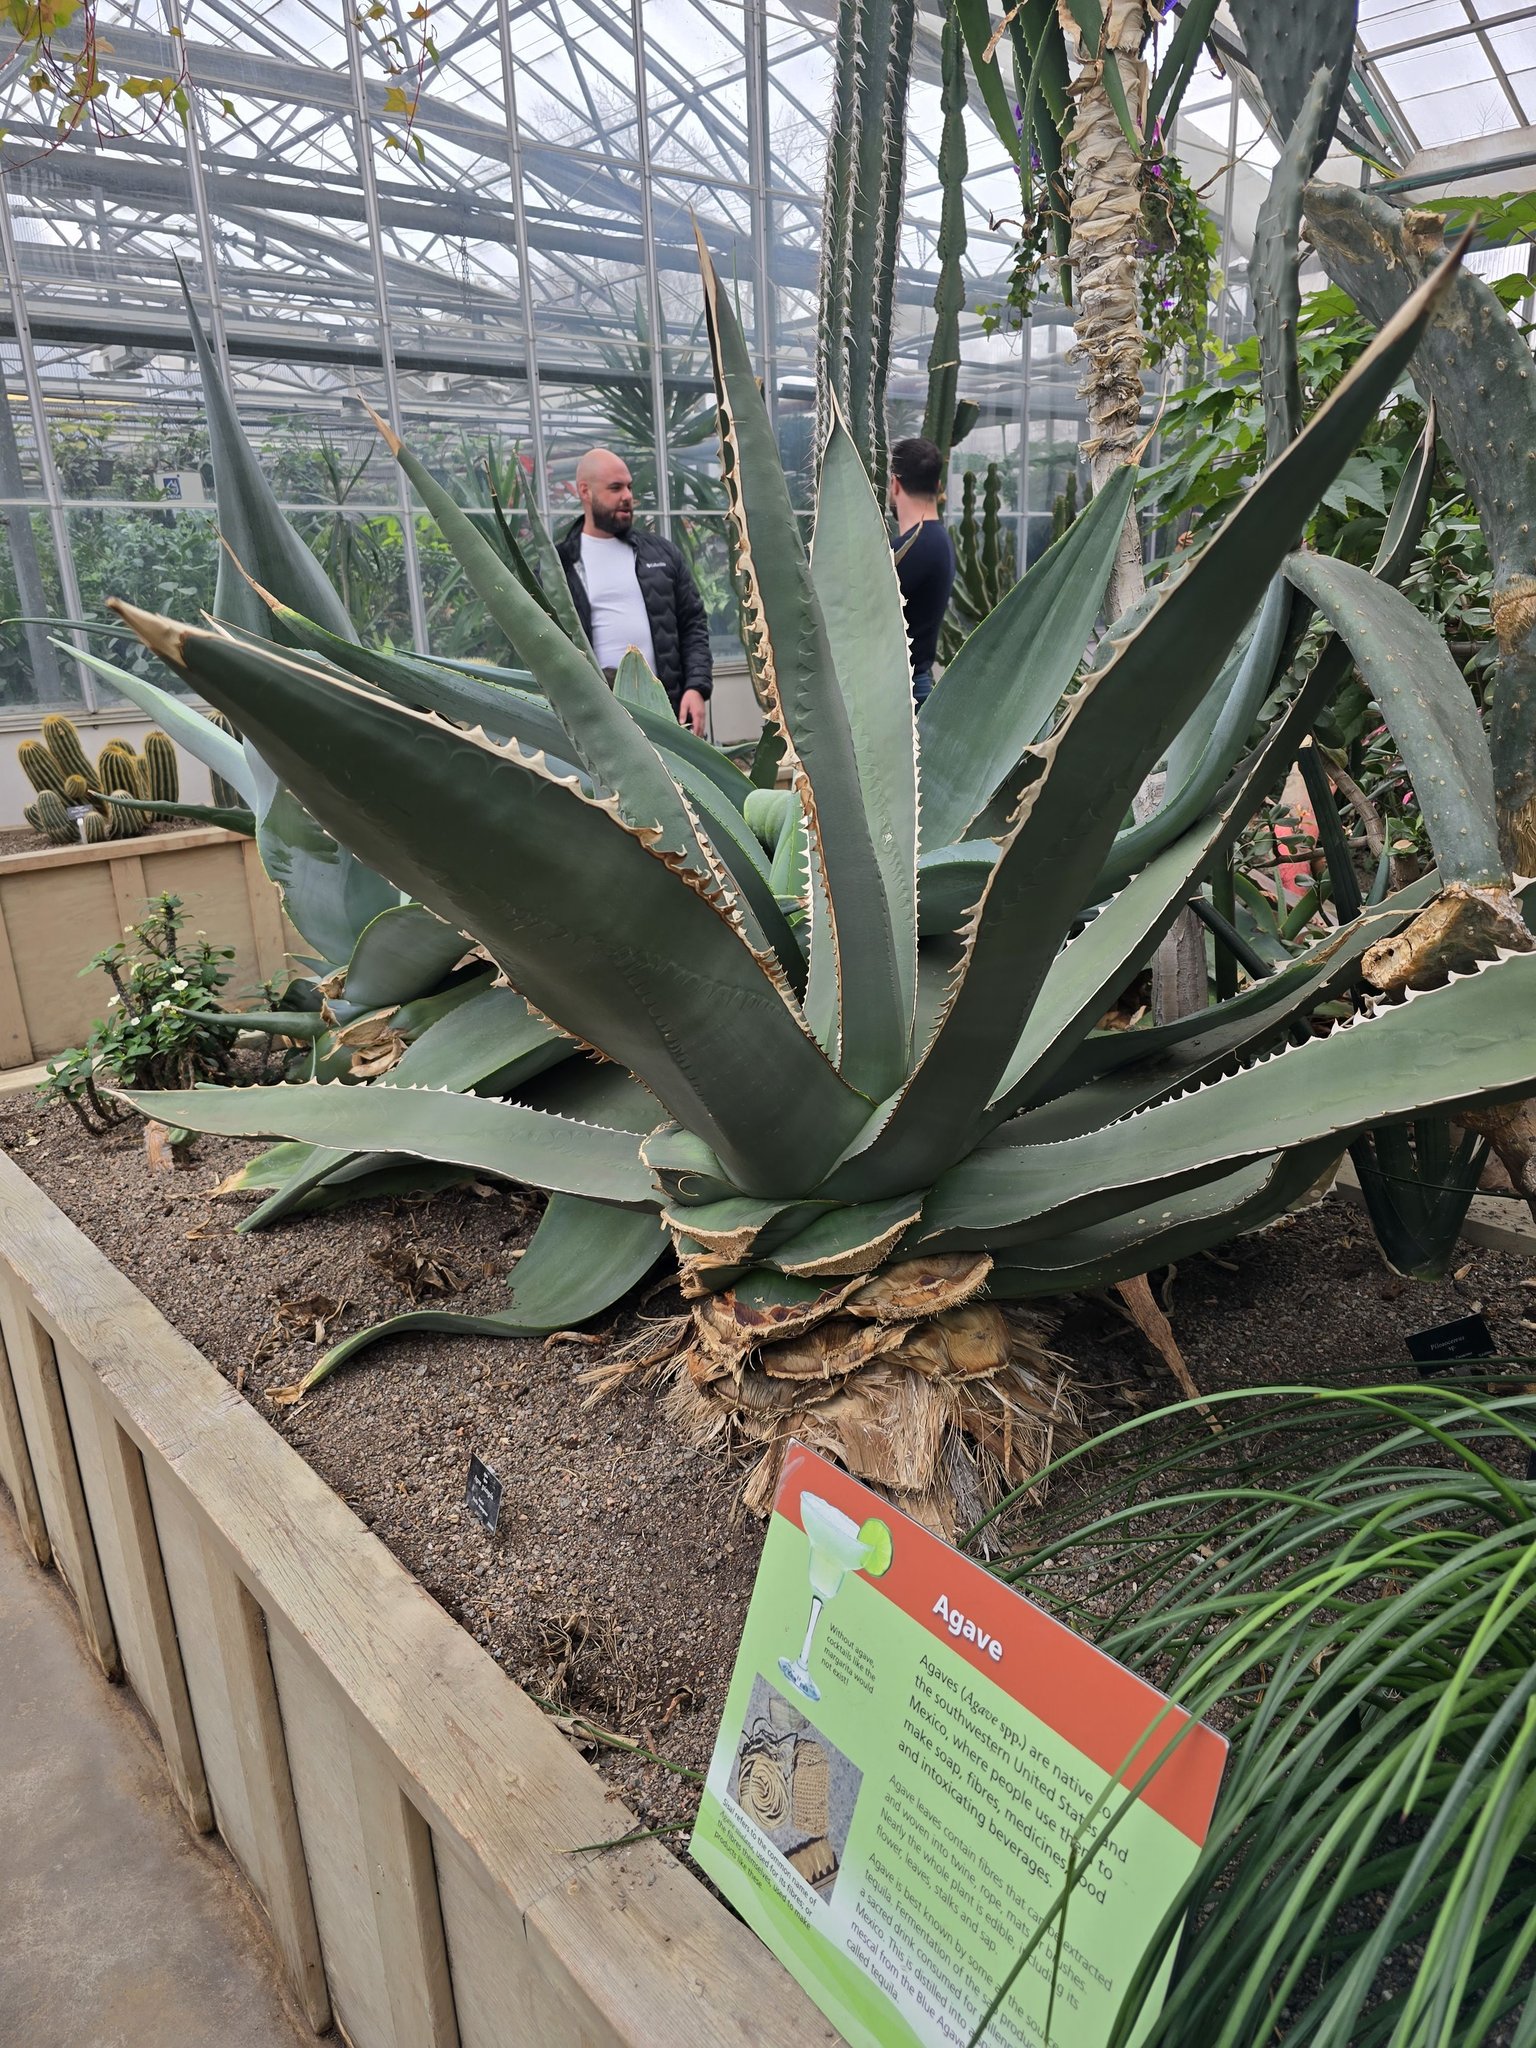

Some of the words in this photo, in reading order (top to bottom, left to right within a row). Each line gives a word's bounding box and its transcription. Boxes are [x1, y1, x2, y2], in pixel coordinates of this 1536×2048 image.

[820, 1657, 832, 1672] not
[832, 1667, 849, 1686] exist!
[823, 1646, 853, 1676] margarita
[853, 1672, 874, 1694] would
[826, 1635, 852, 1661] cocktails
[852, 1655, 864, 1672] like
[864, 1667, 876, 1682] the
[829, 1622, 855, 1650] Without
[854, 1646, 875, 1669] agave,
[932, 1594, 1002, 1661] Agave
[909, 1694, 949, 1741] Mexico,
[952, 1734, 989, 1773] where
[989, 1767, 1032, 1811] people
[1034, 1806, 1057, 1832] use
[1098, 1859, 1113, 1881] to
[914, 1674, 933, 1698] the
[933, 1693, 1010, 1764] southwestern
[1013, 1756, 1057, 1802] United
[1101, 1830, 1129, 1863] and
[919, 1654, 959, 1693] Agaves
[960, 1685, 999, 1726] (Agave
[999, 1722, 1027, 1751] spp.)
[1028, 1745, 1050, 1769] are
[1052, 1764, 1093, 1805] native
[713, 1829, 737, 1859] products
[717, 1819, 727, 1833] the
[726, 1829, 742, 1851] fibres
[741, 1847, 772, 1888] themselves,
[772, 1884, 787, 1903] used
[786, 1899, 794, 1911] to
[793, 1908, 811, 1930] make
[722, 1797, 736, 1815] Sisal
[734, 1812, 750, 1833] refers
[750, 1828, 757, 1840] to
[757, 1836, 767, 1852] the
[766, 1849, 792, 1879] common
[791, 1876, 809, 1899] name
[808, 1896, 817, 1907] of
[884, 1792, 902, 1813] and
[902, 1807, 930, 1840] woven
[930, 1833, 949, 1859] into
[950, 1853, 977, 1889] twine,
[979, 1884, 1003, 1915] rope,
[1006, 1909, 1031, 1938] mats
[898, 1739, 920, 1765] and
[920, 1756, 986, 1828] intoxicating
[988, 1817, 1052, 1888] beverages.
[903, 1718, 933, 1751] make
[934, 1746, 962, 1780] soap,
[966, 1771, 1001, 1814] fibres,
[1079, 1870, 1107, 1905] ood
[755, 1850, 770, 1868] used
[769, 1864, 779, 1878] for
[778, 1874, 786, 1888] its
[804, 1906, 813, 1917] or
[864, 1868, 893, 1906] tequila.
[895, 1899, 951, 1966] Fermentation
[952, 1963, 965, 1978] of
[964, 1973, 981, 1997] the
[876, 1823, 903, 1860] flower,
[904, 1851, 932, 1890] leaves,
[933, 1884, 959, 1915] stalks
[959, 1911, 979, 1934] and
[979, 1930, 998, 1955] sap.
[880, 1806, 907, 1841] Nearly
[907, 1833, 922, 1855] the
[923, 1850, 950, 1882] whole
[949, 1878, 975, 1907] plant
[975, 1899, 984, 1916] is
[984, 1912, 1015, 1950] edible,
[1018, 1945, 1064, 1997] icludig
[1066, 1991, 1080, 2011] its
[888, 1773, 916, 1804] Agave
[916, 1797, 942, 1830] leaves
[943, 1826, 976, 1863] contain
[977, 1856, 1004, 1889] fibres
[1005, 1883, 1026, 1910] that
[1062, 1940, 1113, 1992] extracted
[846, 1938, 871, 1968] called
[870, 1963, 899, 2004] tequila.
[850, 1921, 879, 1956] mescal
[879, 1949, 899, 1979] from
[900, 1973, 915, 1996] the
[915, 1990, 936, 2019] Blue
[936, 2015, 965, 2048] Agave
[855, 1901, 885, 1942] Mexico.
[888, 1935, 905, 1962] This
[904, 1955, 913, 1971] is
[914, 1967, 948, 2008] distilled
[948, 2001, 967, 2030] into
[859, 1887, 866, 1898] a
[866, 1894, 894, 1927] sacred
[893, 1922, 916, 1952] drink
[916, 1947, 963, 2000] consumed
[963, 1994, 978, 2016] for
[868, 1852, 895, 1884] Agave
[895, 1876, 903, 1892] is
[903, 1885, 922, 1913] best
[922, 1905, 953, 1945] known
[954, 1938, 967, 1960] by
[967, 1954, 993, 1986] some
[1007, 1994, 1024, 2018] the
[1026, 2015, 1059, 2048] souce
